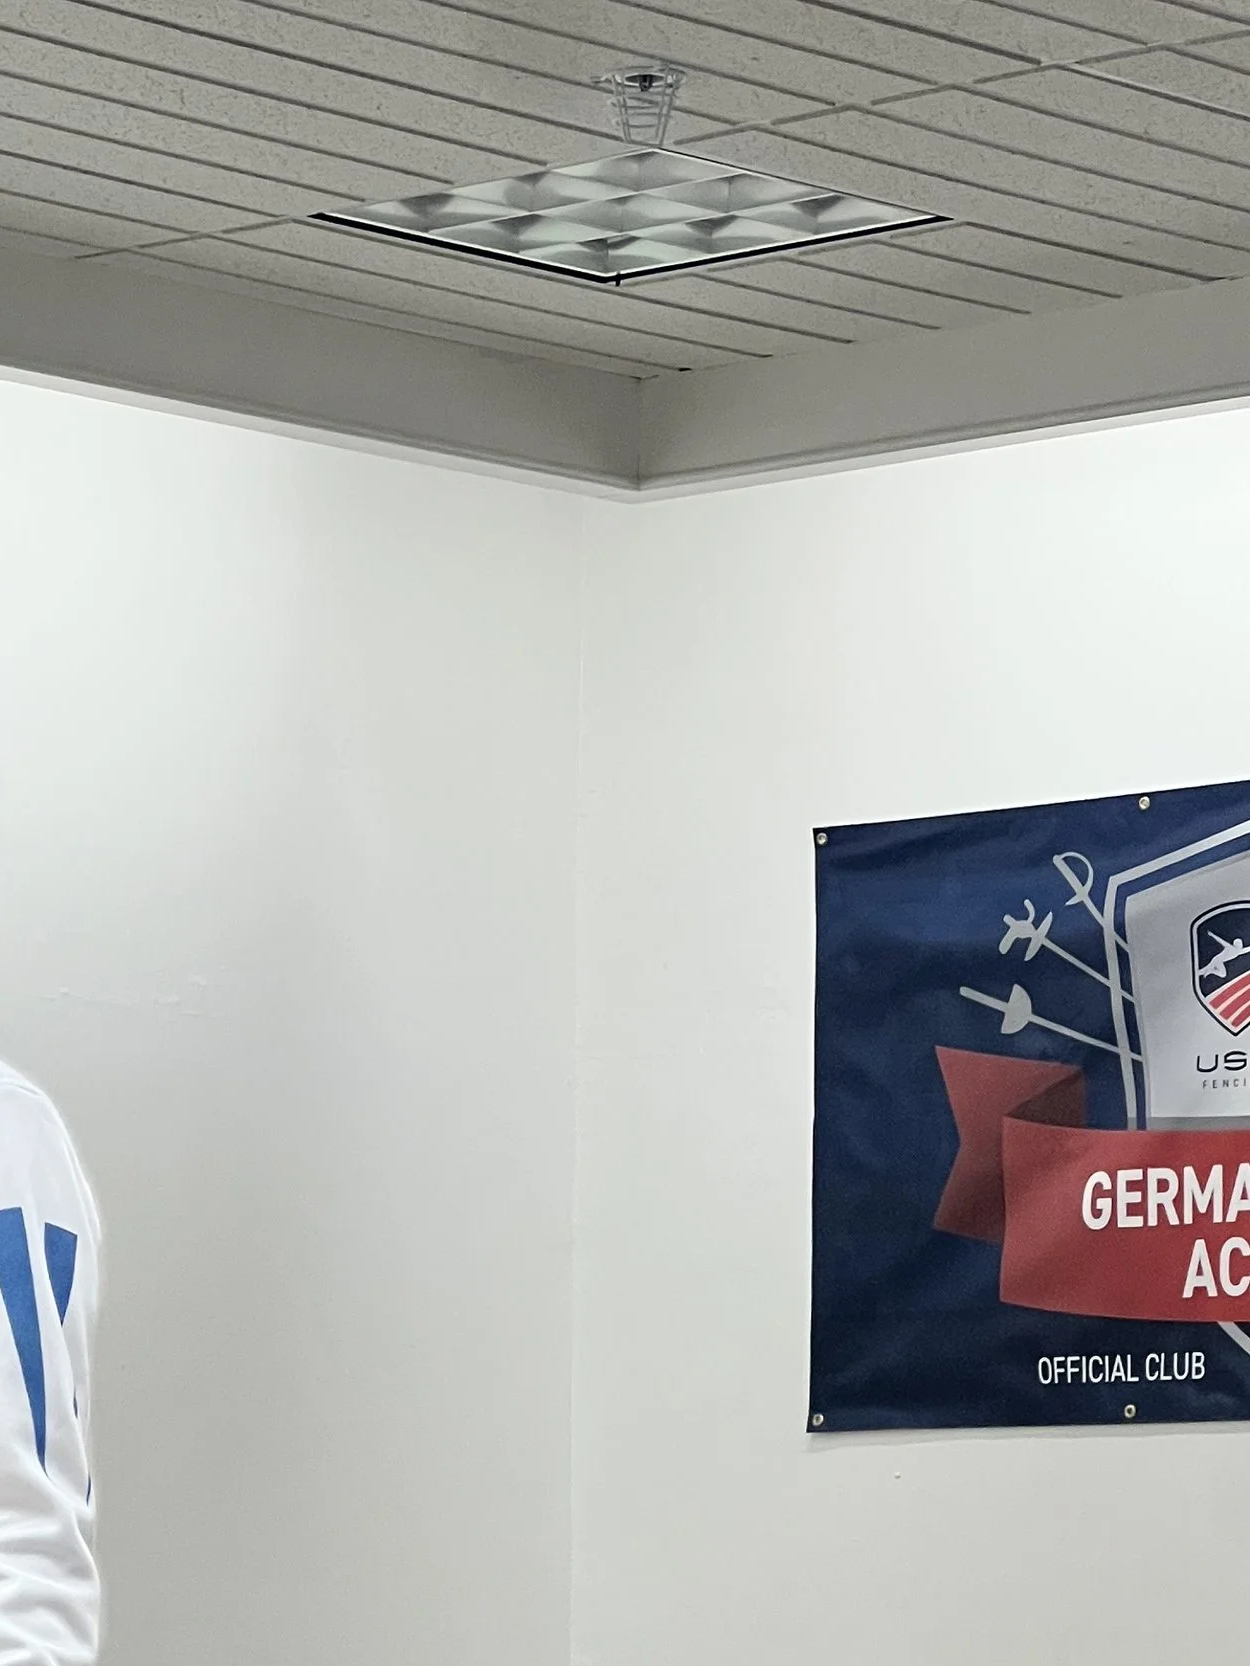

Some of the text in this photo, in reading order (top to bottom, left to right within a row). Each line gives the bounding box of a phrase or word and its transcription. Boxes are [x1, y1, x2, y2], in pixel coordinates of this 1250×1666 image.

[1197, 1051, 1247, 1073] US
[1202, 1077, 1247, 1089] FENCI
[1082, 1162, 1250, 1231] GERMA
[1182, 1236, 1250, 1299] AC
[1037, 1351, 1206, 1385] OFFICIAL CLUB
